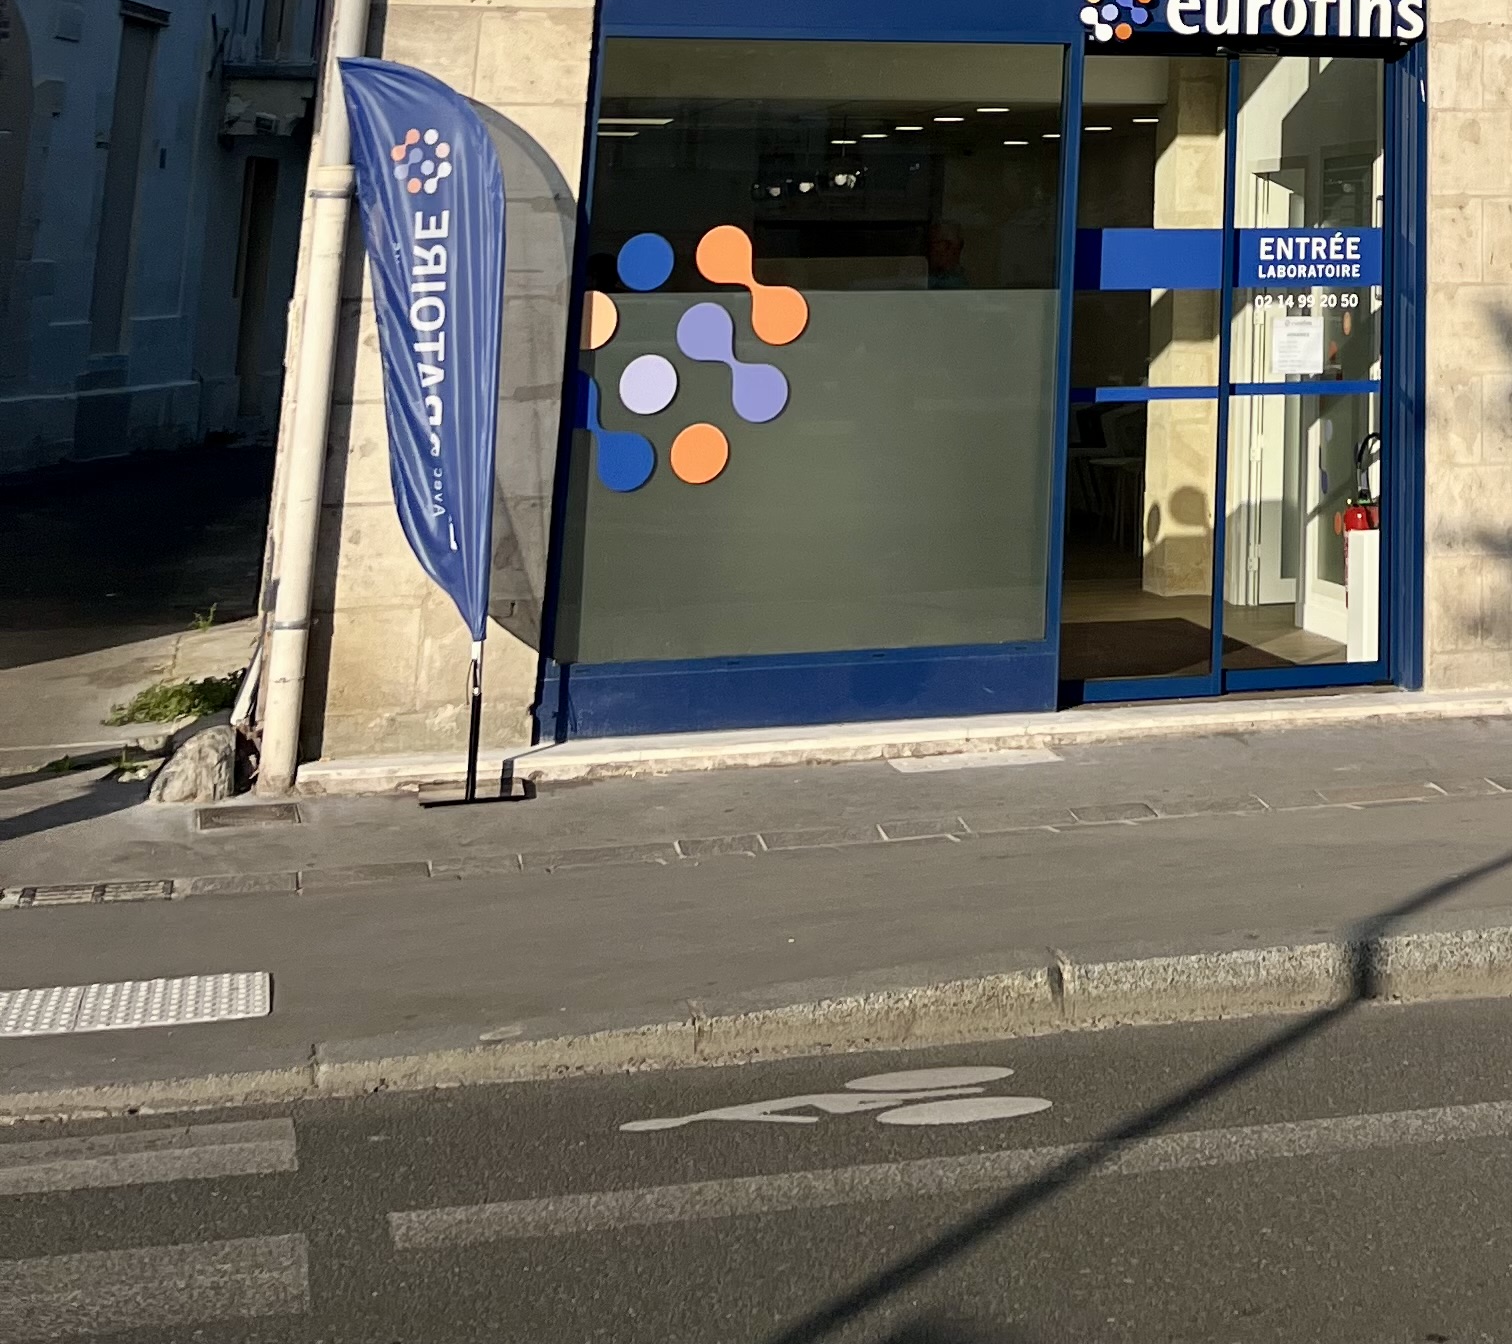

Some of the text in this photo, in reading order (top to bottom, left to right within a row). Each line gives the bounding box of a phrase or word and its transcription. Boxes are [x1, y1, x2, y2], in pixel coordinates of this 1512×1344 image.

[1259, 231, 1362, 261] ENTRÉE
[1257, 263, 1362, 279] LABORATOIRE
[1254, 293, 1359, 309] 02 14 99 20 50
